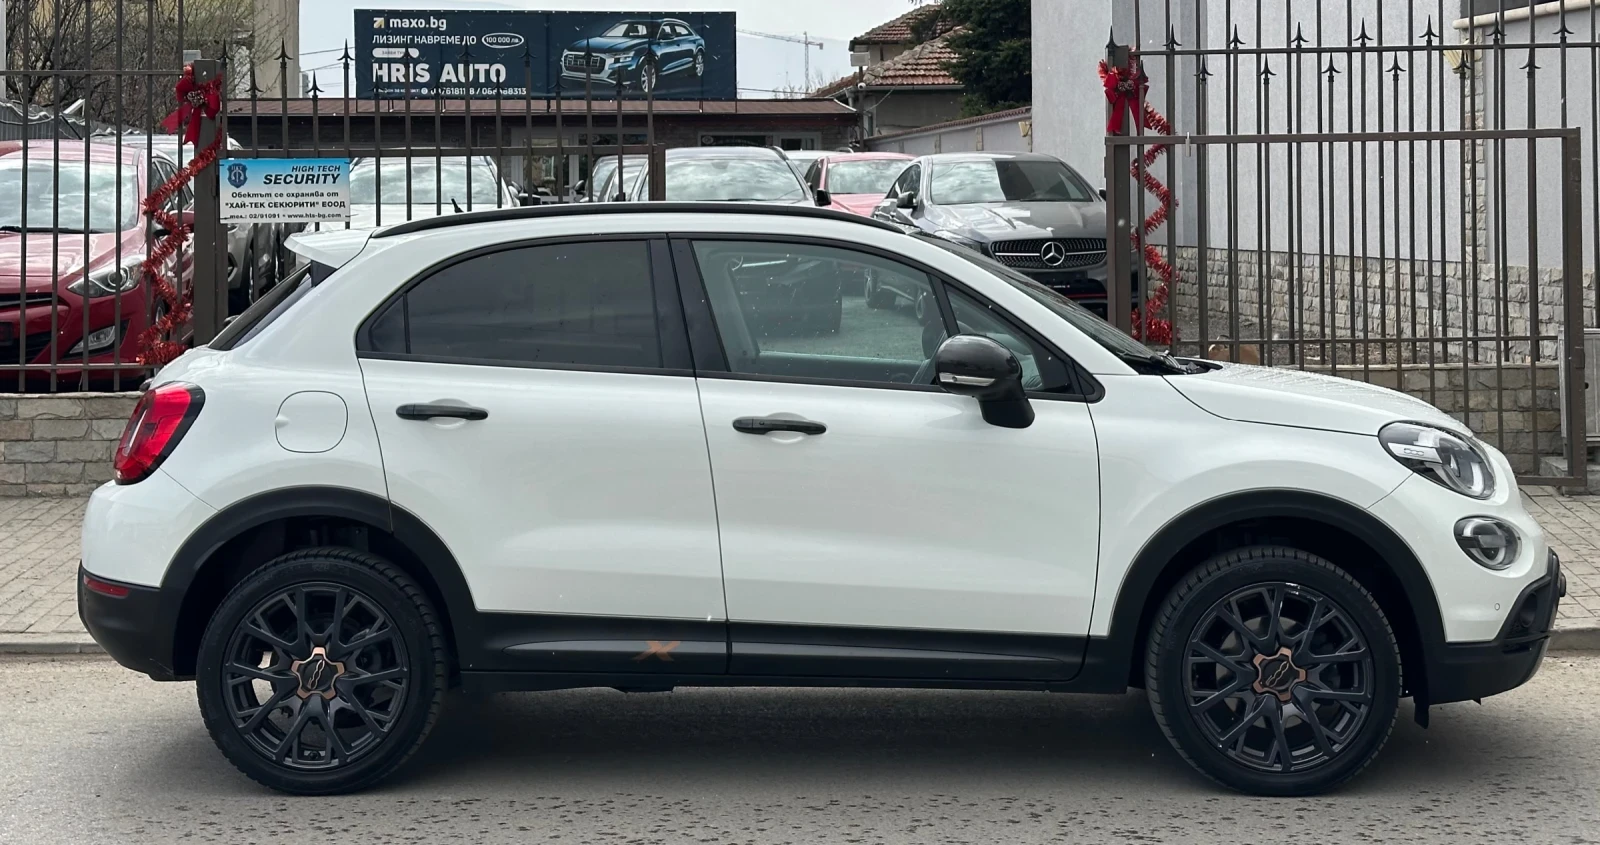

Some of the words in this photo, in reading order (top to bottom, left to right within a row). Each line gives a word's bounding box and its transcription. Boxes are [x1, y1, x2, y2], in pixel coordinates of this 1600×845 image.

[389, 16, 446, 30] maxo.bg
[372, 35, 413, 45] ЛИЗИНГ
[414, 35, 461, 45] НАВРЕМЕ
[462, 35, 477, 45] ДО
[486, 36, 497, 44] 100
[498, 36, 510, 44] 000
[372, 63, 431, 82] HRIS
[440, 63, 506, 82] AUTO
[263, 173, 341, 184] SECURITY
[231, 191, 272, 199] Обектът
[286, 191, 325, 199] охранява
[225, 201, 265, 209] "ХАЙ-ТЕК
[267, 201, 320, 209] СЕКЮРИТИ"
[321, 201, 346, 209] ЕООД
